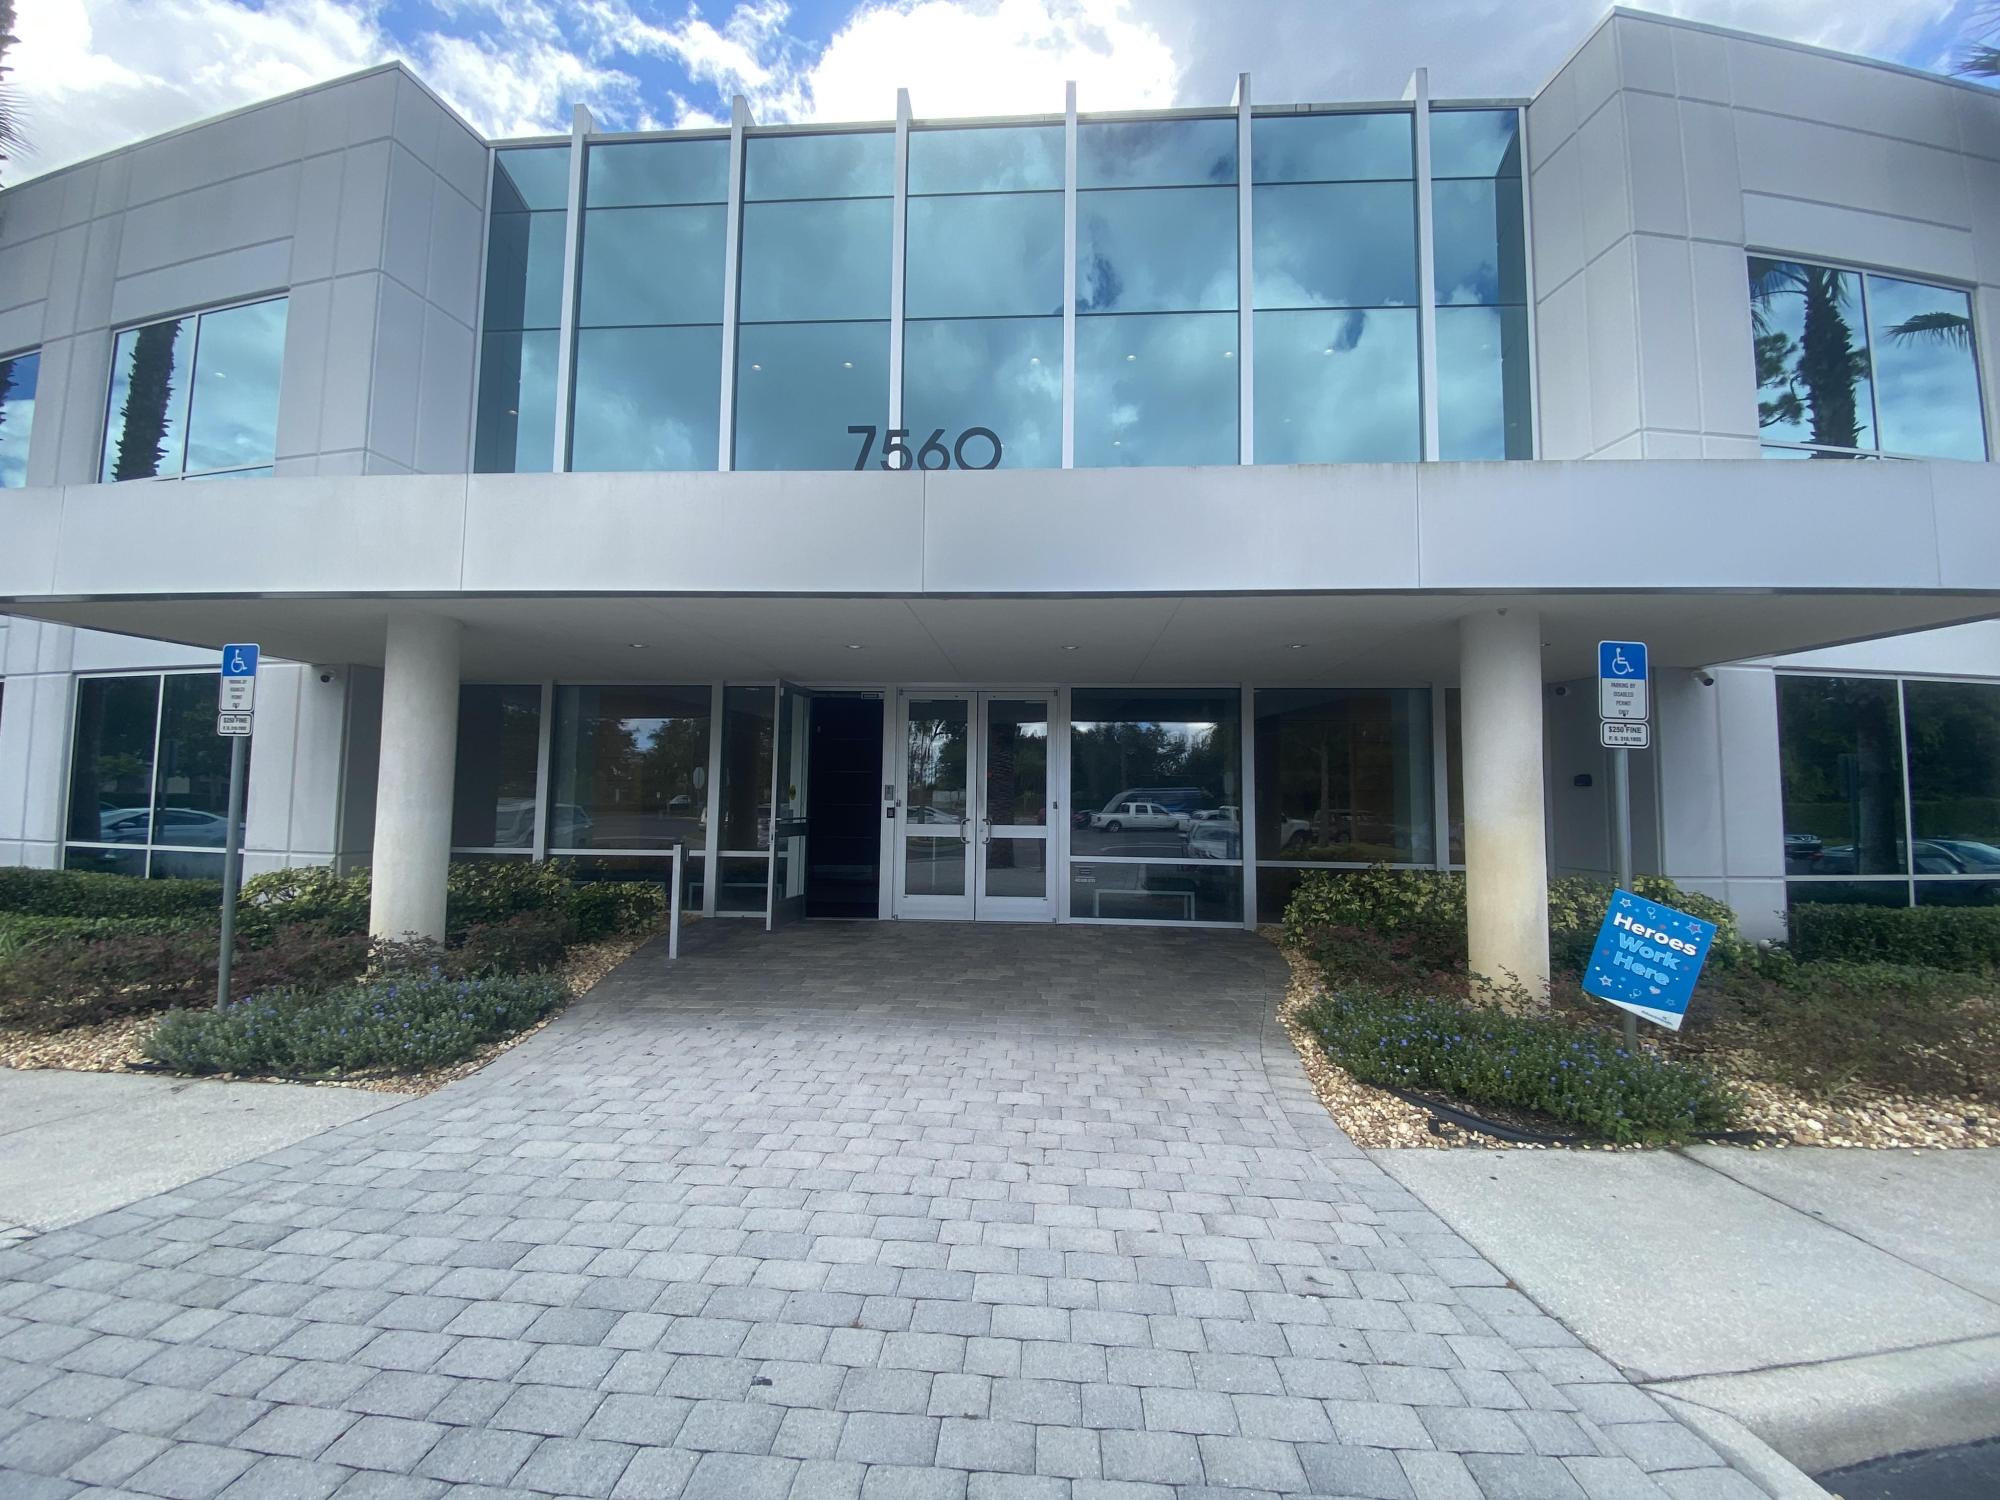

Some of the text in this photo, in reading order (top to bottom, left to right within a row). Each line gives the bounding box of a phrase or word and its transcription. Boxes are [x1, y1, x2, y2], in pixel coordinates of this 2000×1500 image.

[847, 425, 1002, 470] 7560
[1625, 726, 1642, 734] FINE
[1613, 912, 1697, 956] Heroes
[1619, 932, 1681, 970] Work
[1613, 951, 1670, 986] Here
